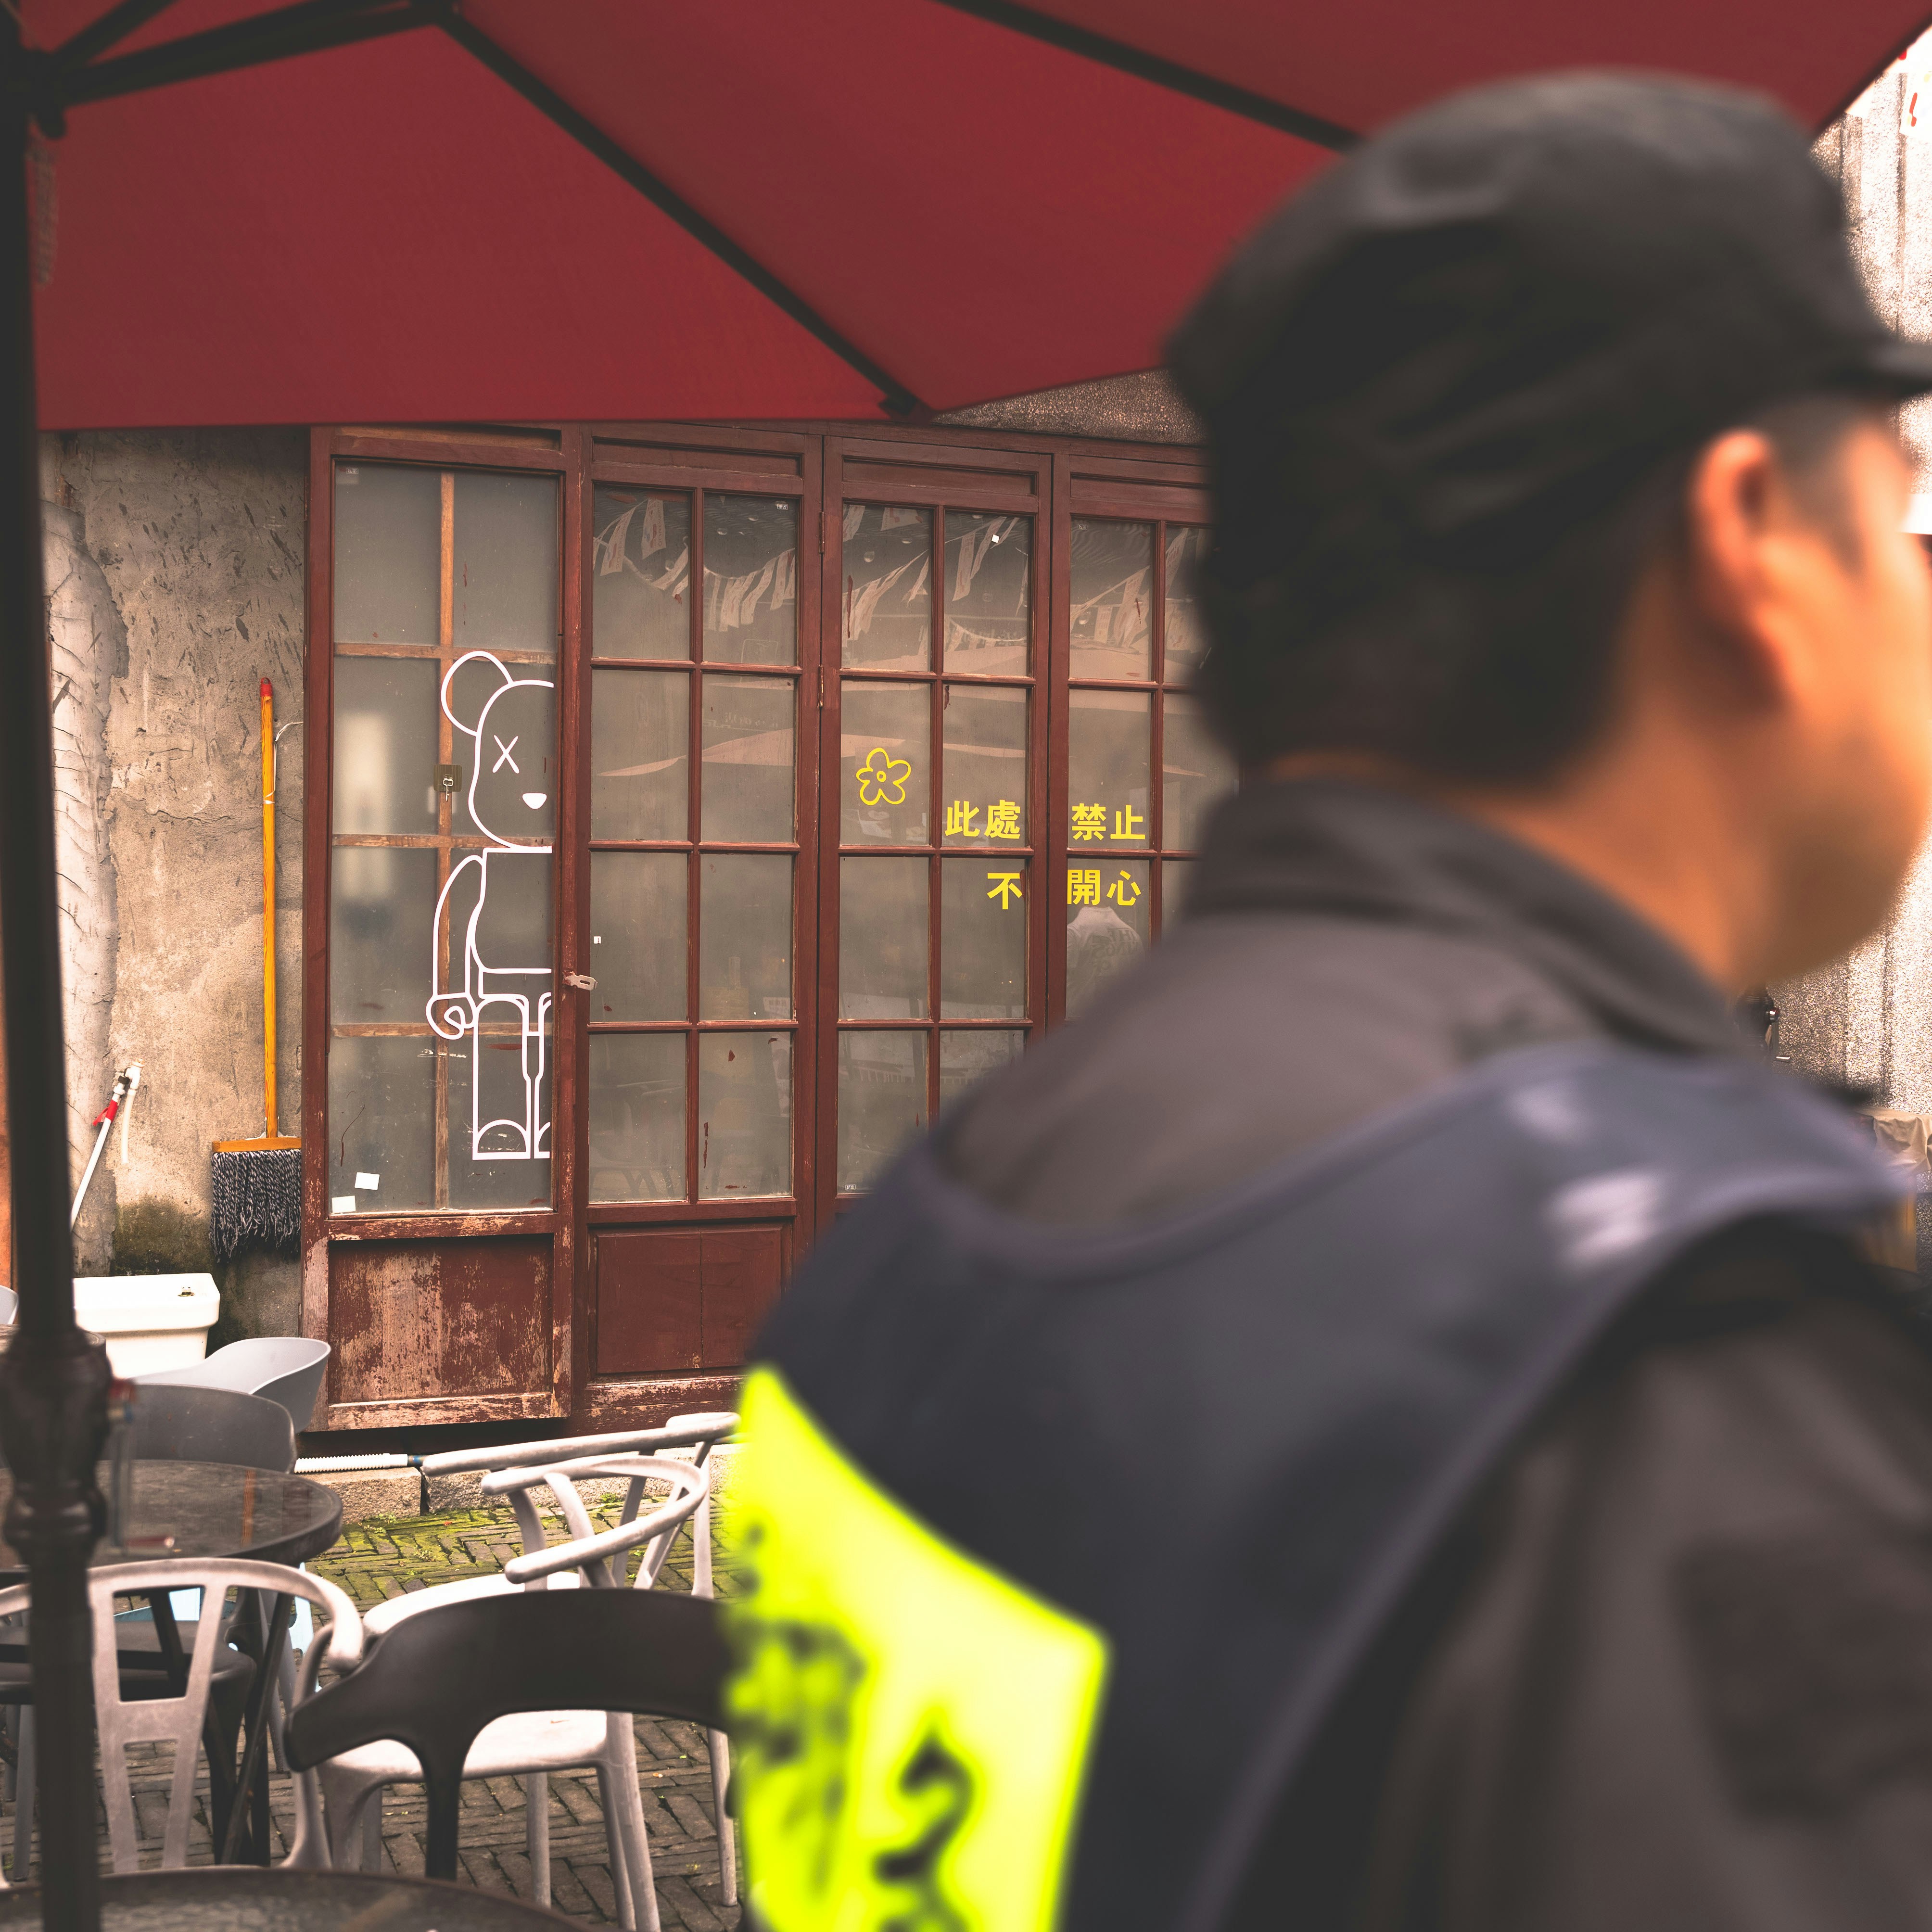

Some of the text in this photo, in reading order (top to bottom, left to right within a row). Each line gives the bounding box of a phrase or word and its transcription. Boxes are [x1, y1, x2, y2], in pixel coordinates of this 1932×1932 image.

[945, 800, 1145, 840] 此處 禁止
[987, 870, 1141, 910] 不 開心
